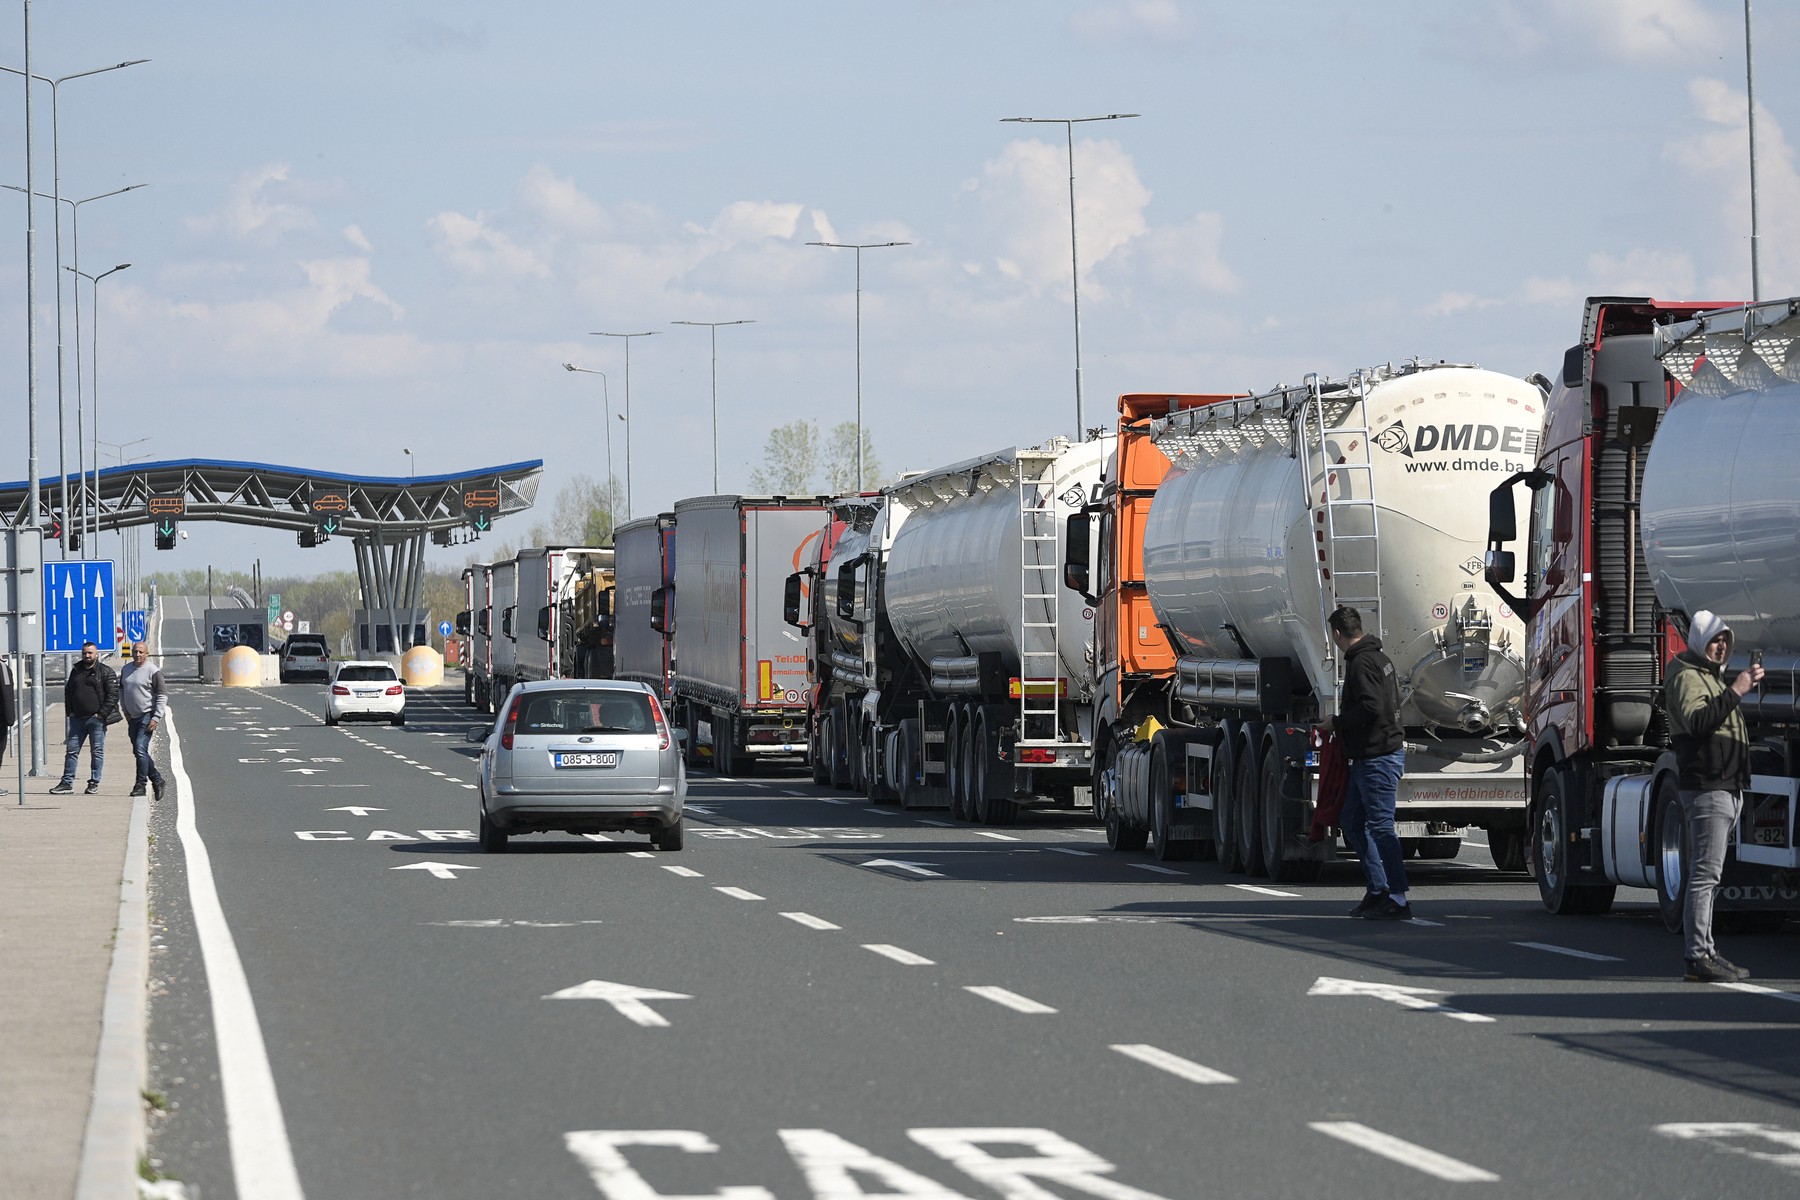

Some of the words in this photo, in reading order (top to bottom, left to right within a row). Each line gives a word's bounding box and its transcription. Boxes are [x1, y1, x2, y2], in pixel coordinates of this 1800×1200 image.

[1405, 458, 1524, 473] www.dmde.ba
[1435, 607, 1445, 616] 70
[788, 691, 796, 700] 70
[563, 755, 615, 765] 085-J-800
[294, 829, 479, 841] CAR
[563, 1127, 1171, 1200] CAR
